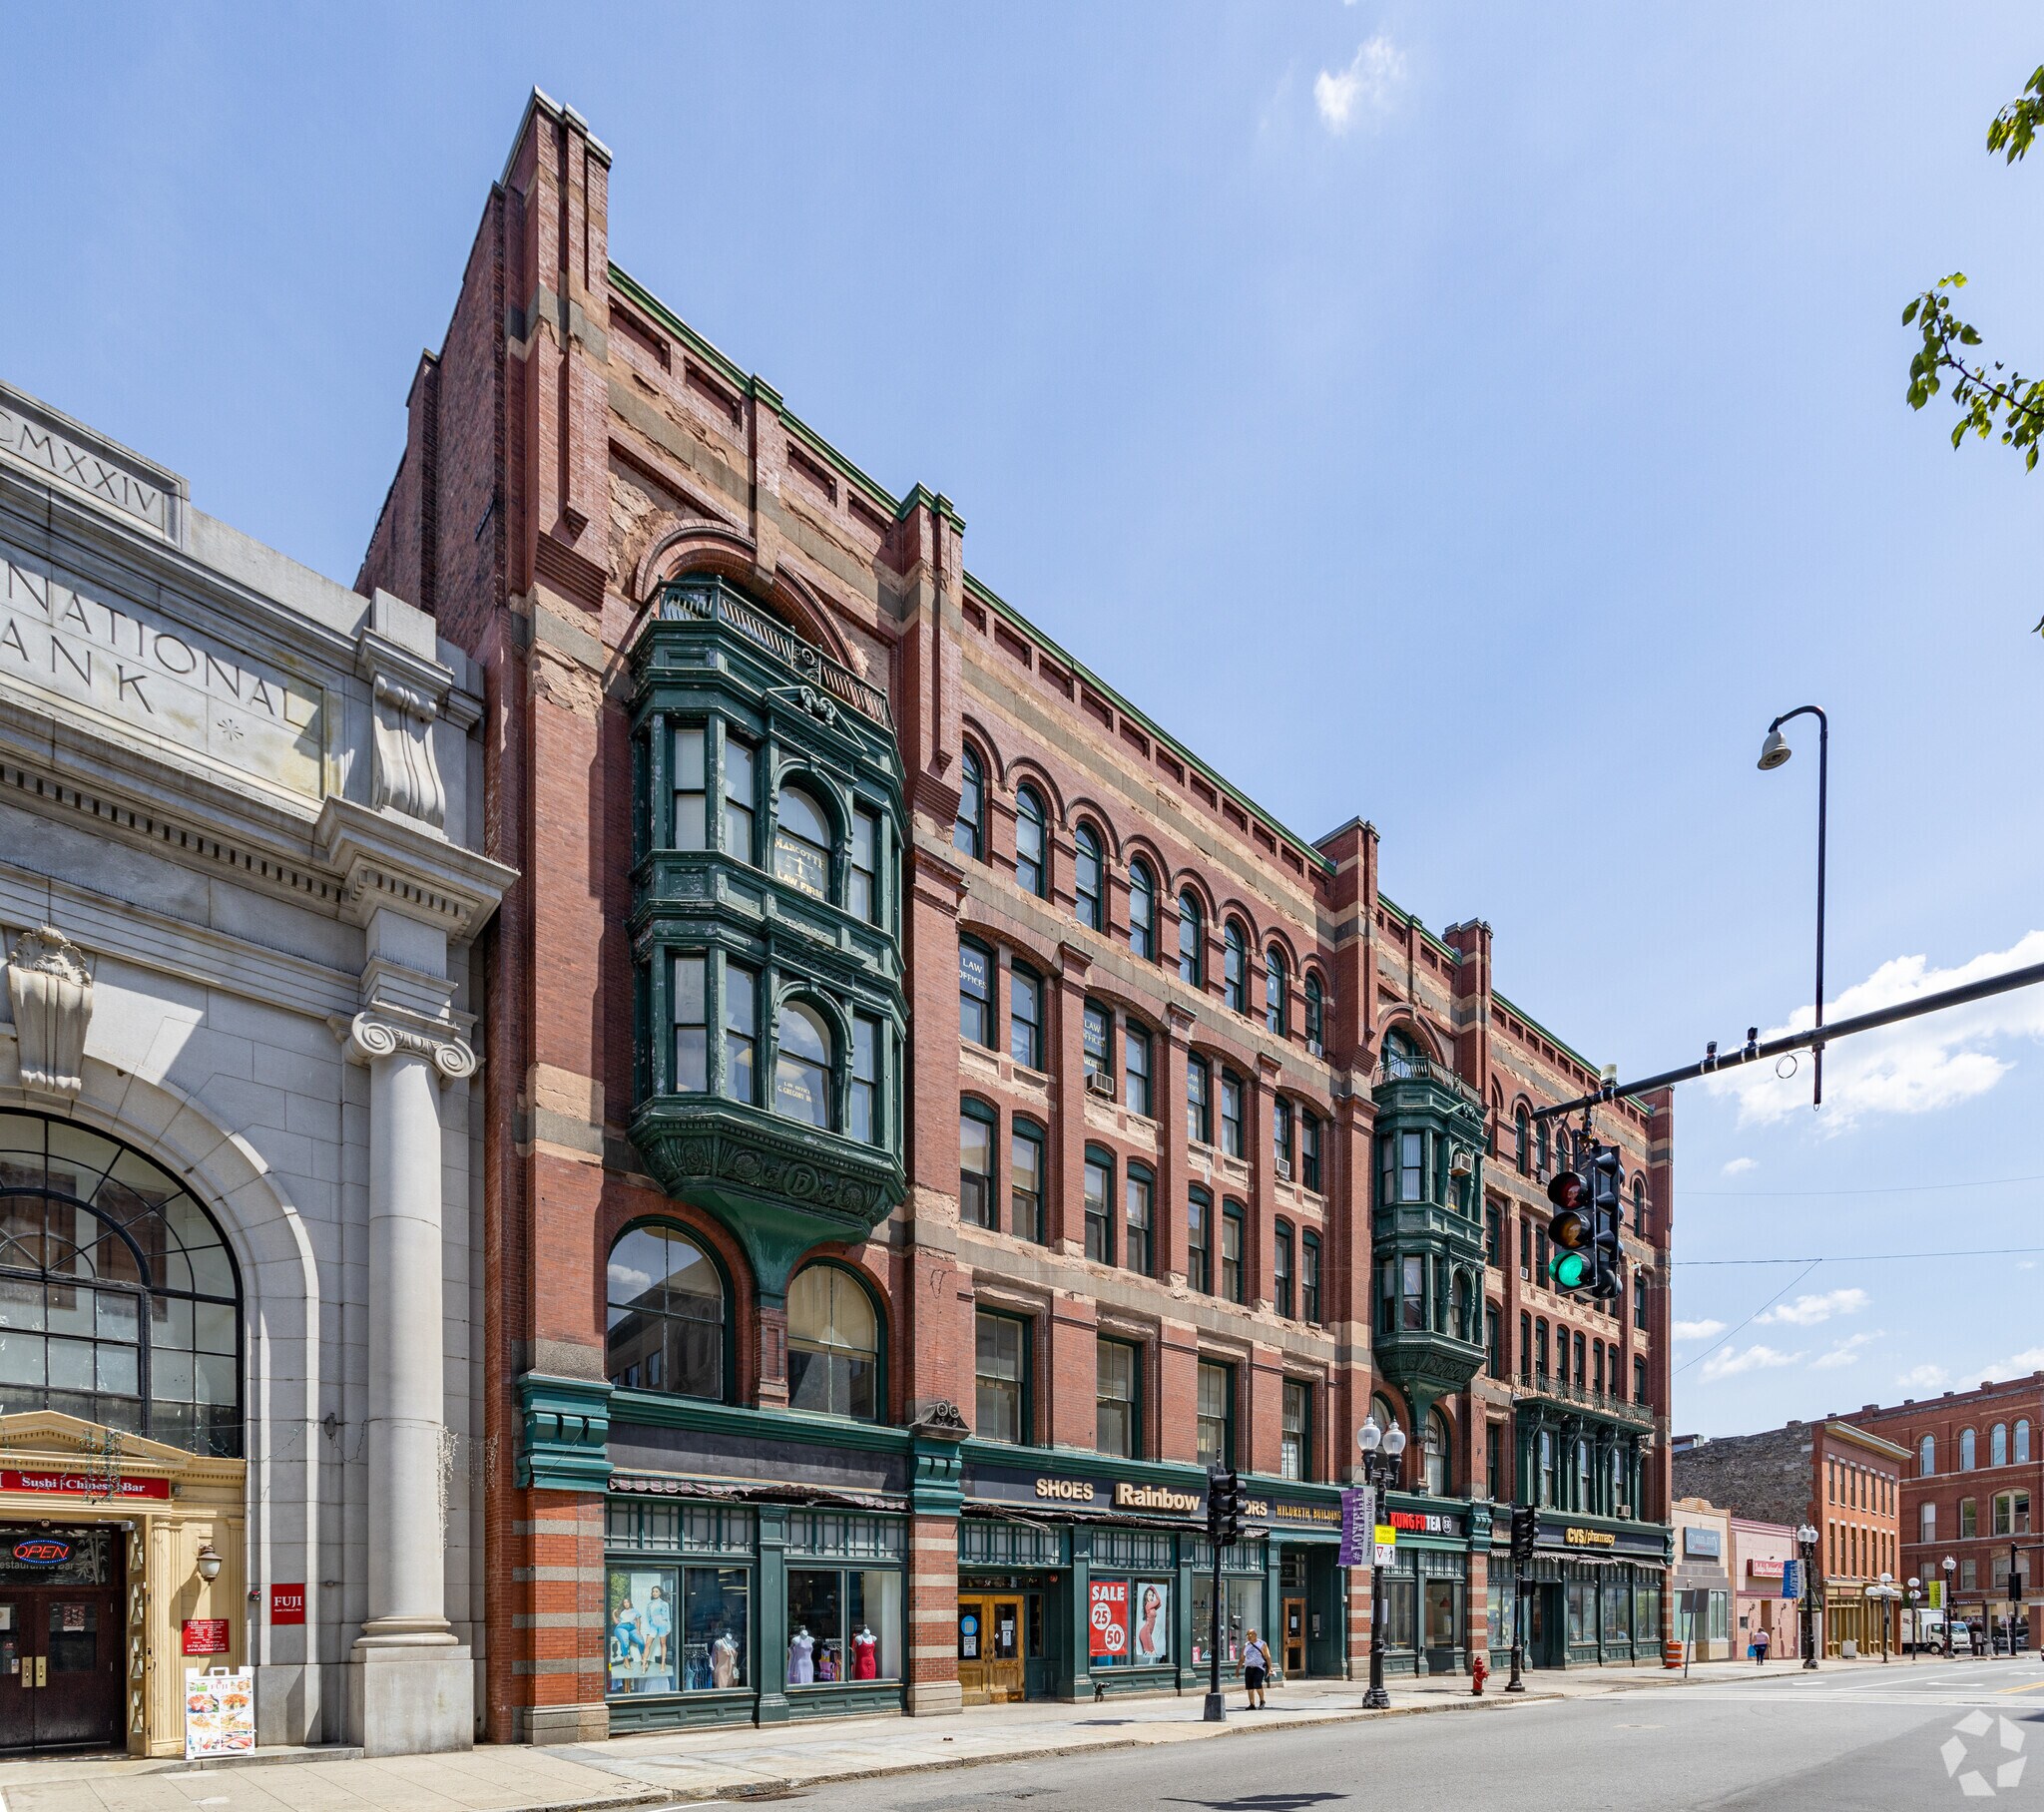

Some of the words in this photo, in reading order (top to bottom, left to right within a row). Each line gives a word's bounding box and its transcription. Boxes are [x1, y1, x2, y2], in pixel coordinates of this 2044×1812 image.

[8, 560, 306, 730] NATIONAL
[774, 838, 825, 870] MARCOTTE
[777, 870, 798, 886] LAW
[799, 882, 823, 899] FIRM
[962, 958, 983, 973] LAW
[1084, 1020, 1101, 1033] LAW
[21, 1477, 58, 1489] Sushi
[123, 1483, 146, 1493] Bar
[1036, 1478, 1094, 1501] SHOES
[1115, 1483, 1201, 1511] Rainbow
[1245, 1500, 1269, 1517] ORS
[1277, 1504, 1310, 1518] HILDRETH
[1312, 1508, 1342, 1522] BUILDING
[1390, 1511, 1415, 1530] KUNG
[1415, 1514, 1426, 1531] FU
[1426, 1515, 1442, 1532] TEA
[1350, 1494, 1364, 1562] #LOWELL
[1565, 1527, 1616, 1547] CVS/pharmacy
[13, 1546, 70, 1559] OPEN
[273, 1595, 302, 1608] FUJI
[1092, 1586, 1126, 1601] SALE
